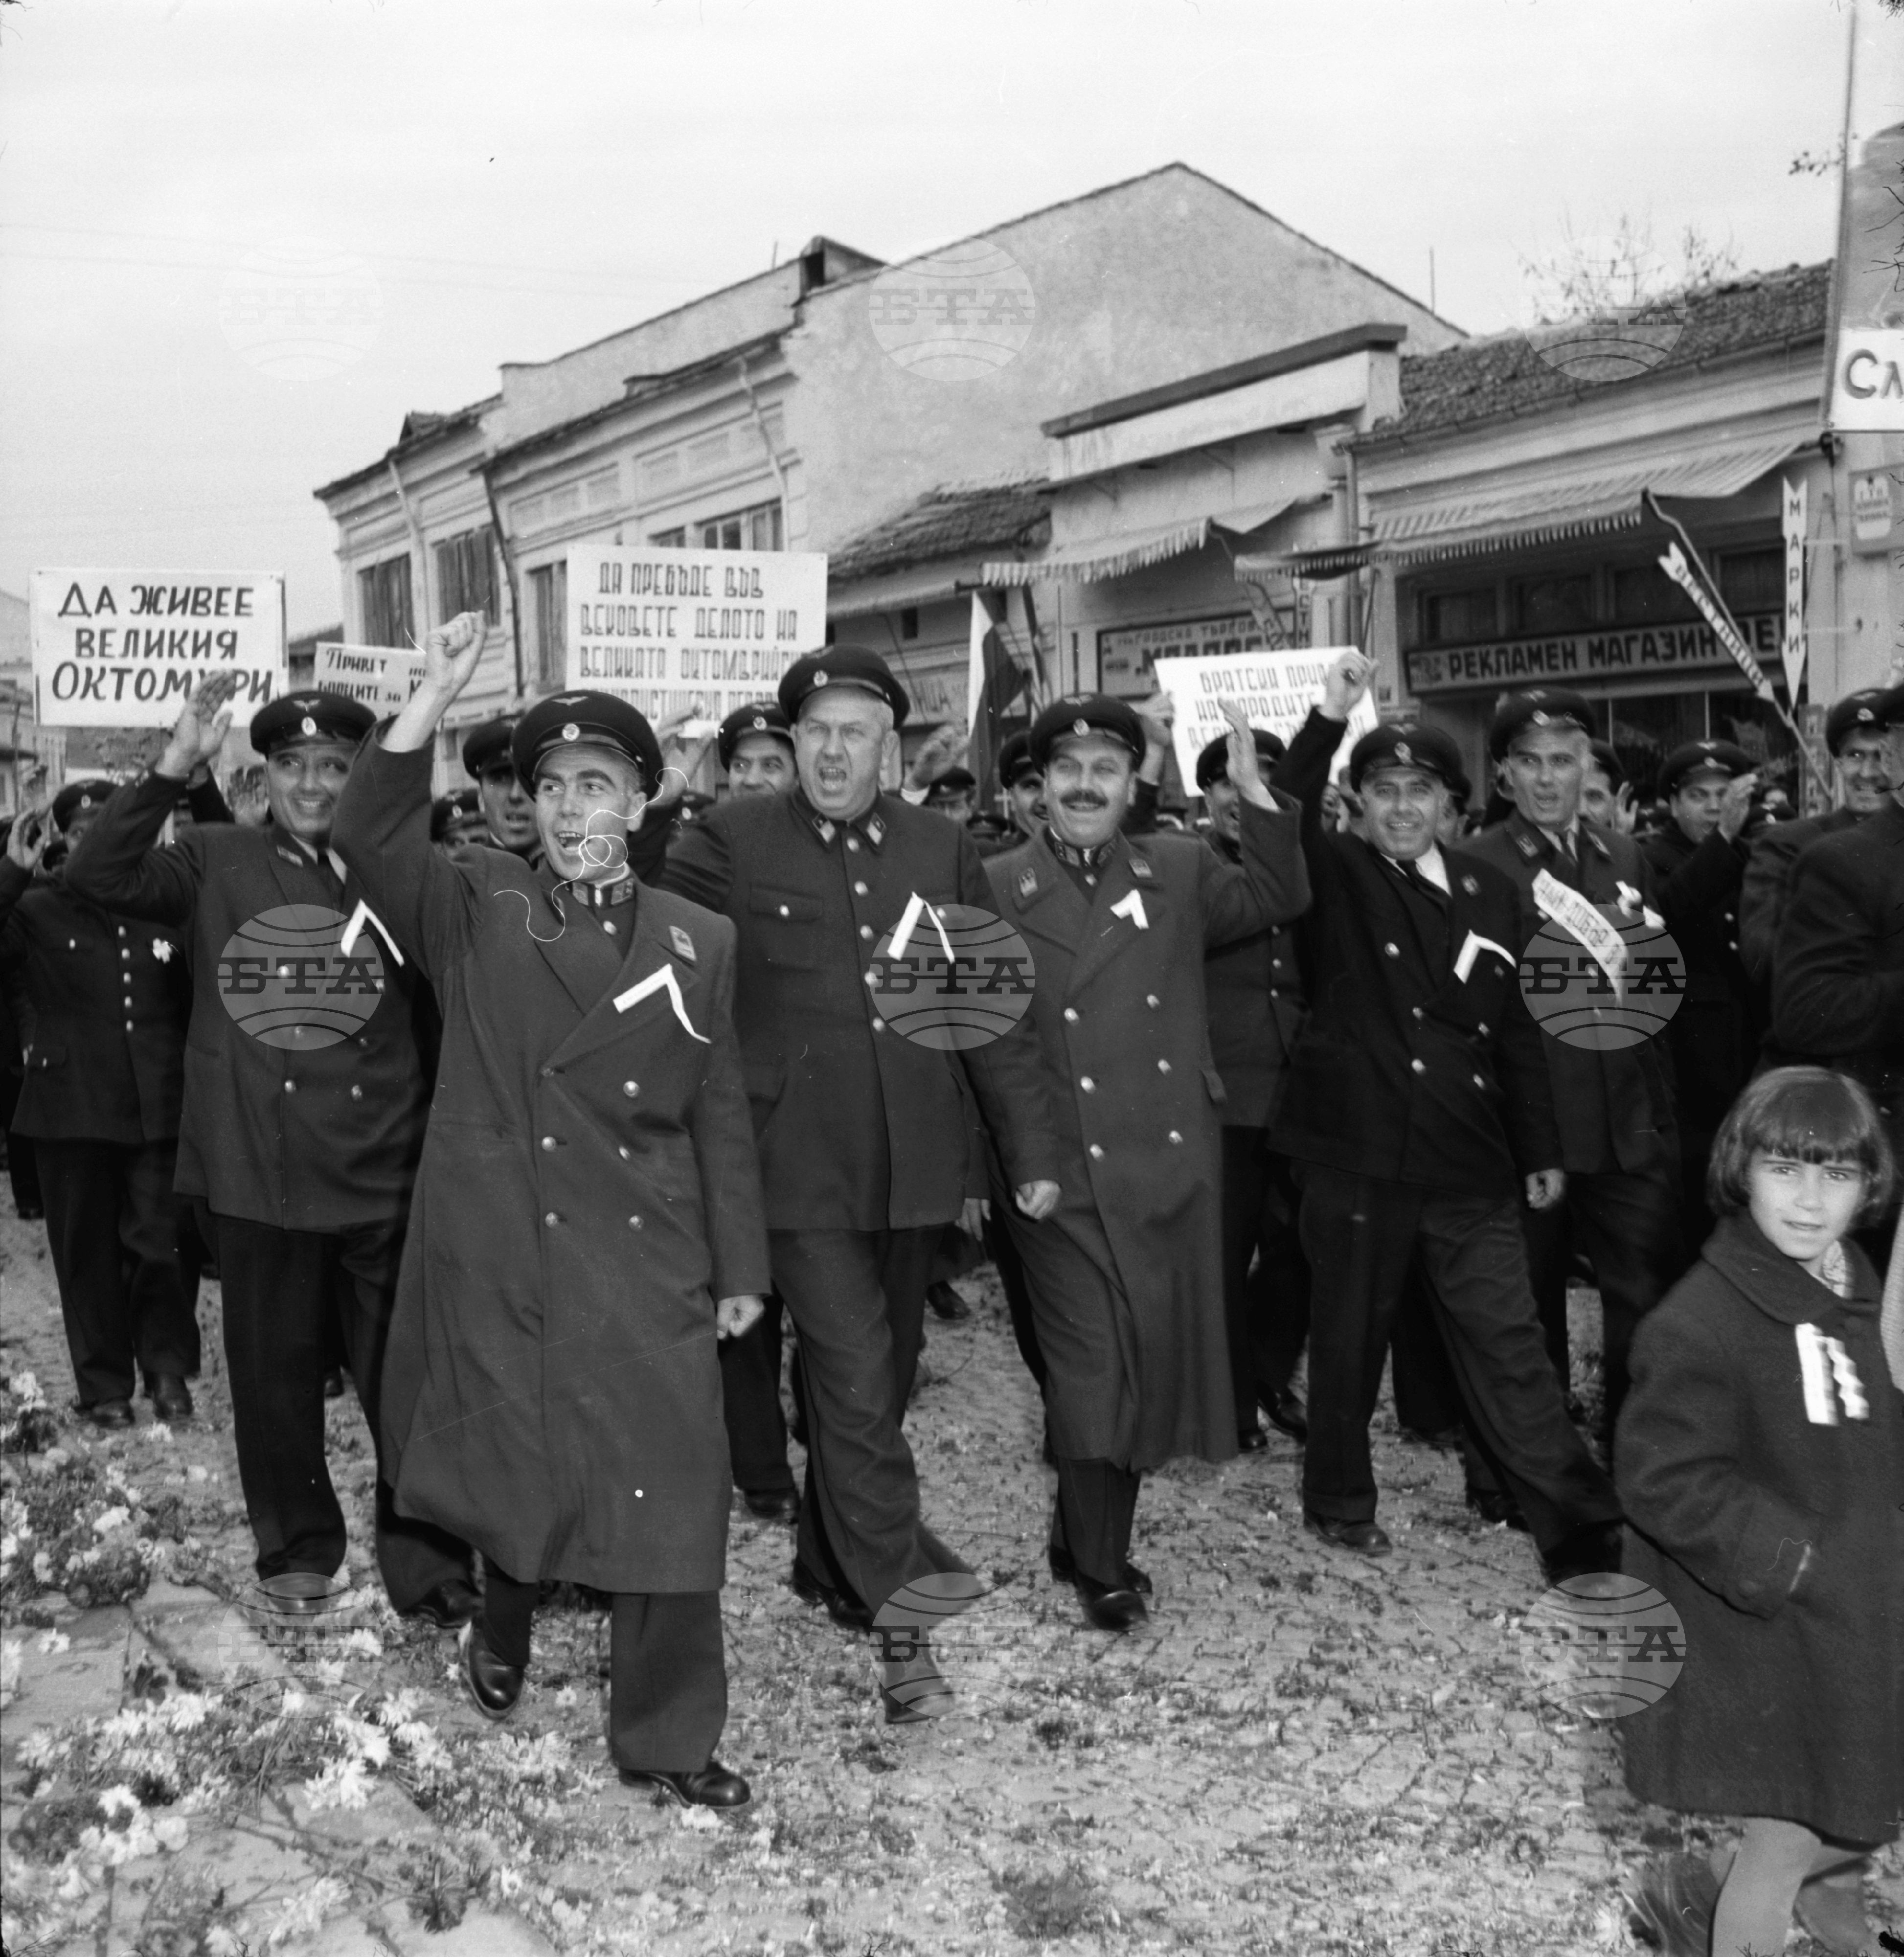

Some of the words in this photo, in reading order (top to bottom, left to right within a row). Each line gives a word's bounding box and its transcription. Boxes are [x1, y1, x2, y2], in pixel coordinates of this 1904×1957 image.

[598, 562, 623, 595] ДА
[631, 563, 713, 597] ПРЕБЪДЕ
[724, 566, 764, 598] ВЪВ
[1789, 498, 1801, 653] МАРКИ
[58, 582, 117, 618] ДА
[130, 585, 254, 617] ЖИВЕЕ
[580, 604, 678, 638] ВЕКОВЕТЕ
[694, 607, 765, 640] ДЕЛОТО
[776, 609, 798, 641] НА
[75, 627, 238, 660] ВЕЛИКИЯ
[1449, 640, 1577, 681] РЕКЛАМЕН
[1587, 624, 1718, 668] МАГАЗИН
[580, 646, 666, 680] ВЕЛИКАТА
[1200, 667, 1280, 694] БРАТСКИ
[52, 661, 272, 703] ОКТОМРИ
[1196, 699, 1219, 722] НА
